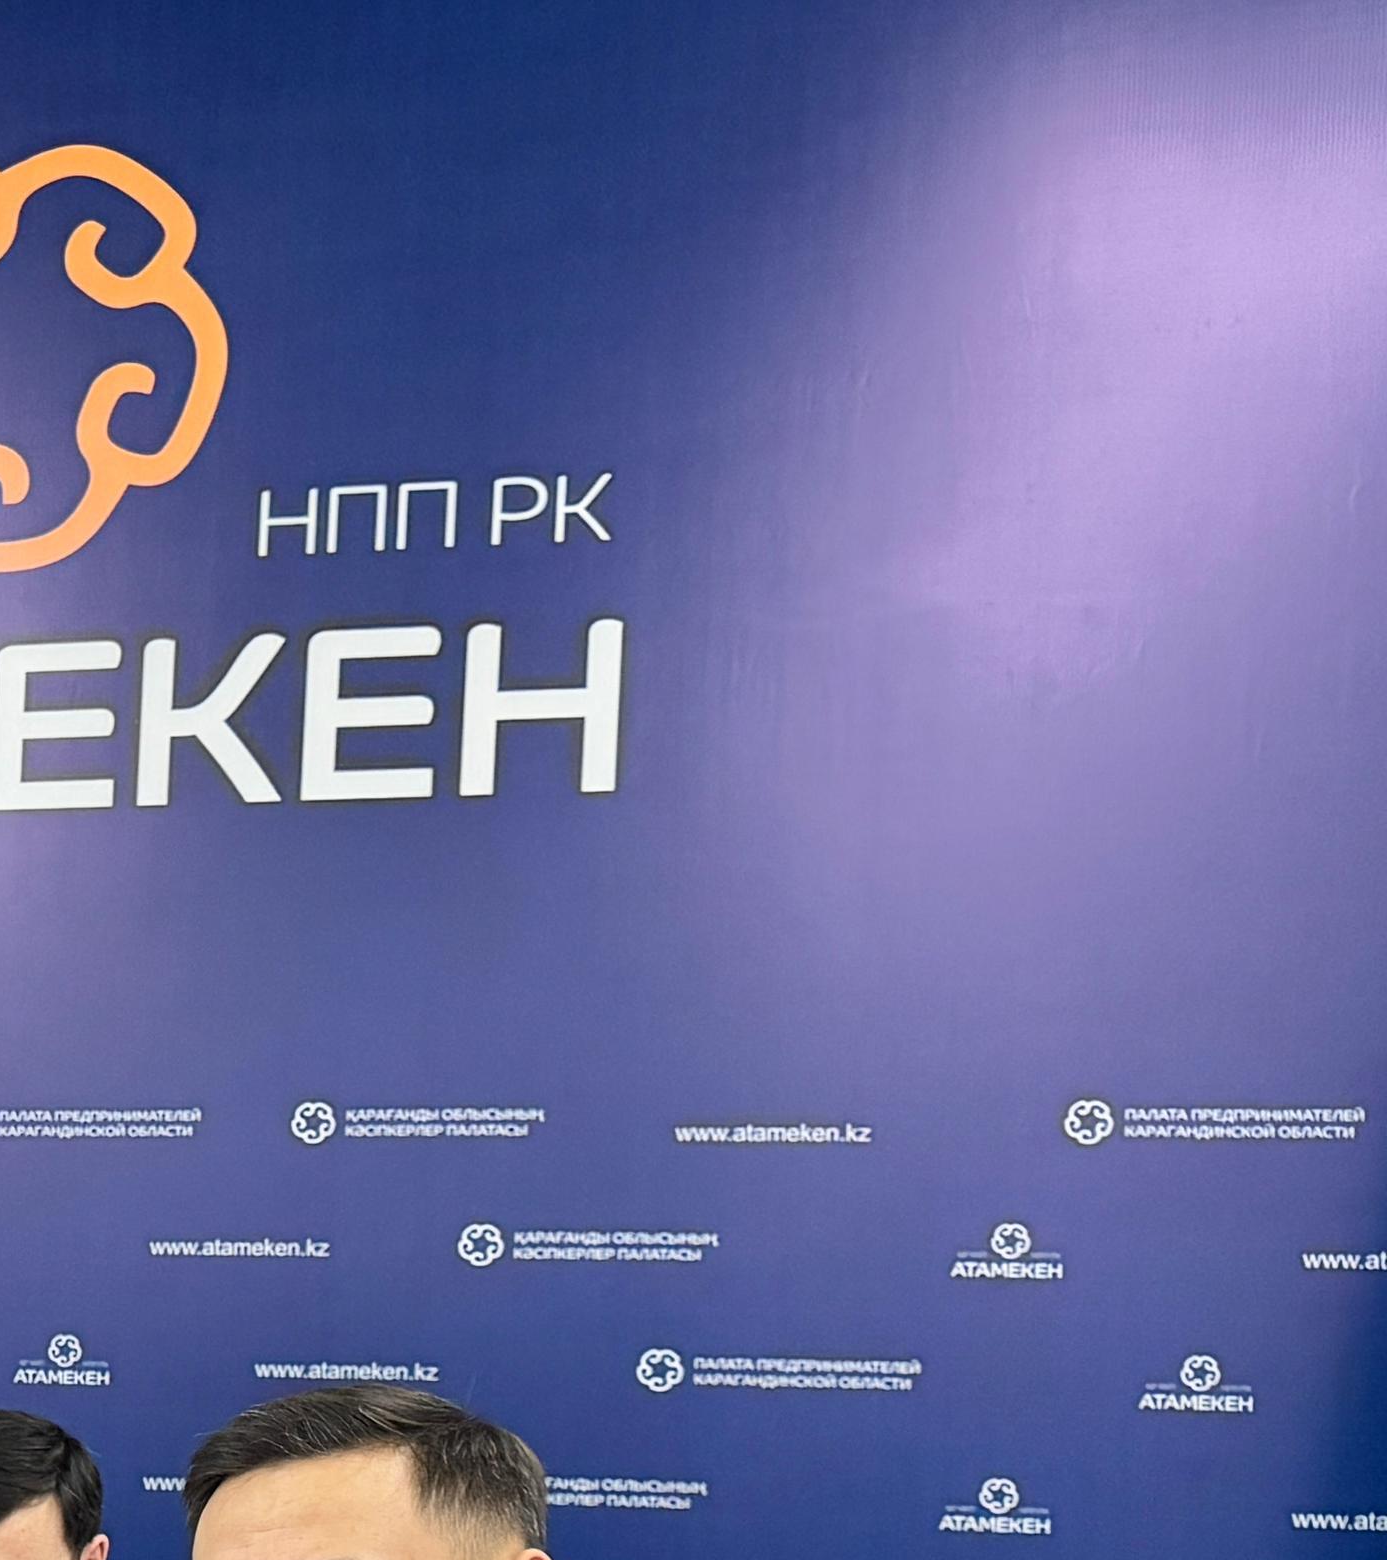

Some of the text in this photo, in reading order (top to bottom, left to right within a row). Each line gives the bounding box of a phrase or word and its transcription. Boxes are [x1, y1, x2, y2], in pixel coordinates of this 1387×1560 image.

[258, 473, 612, 556] НПП РК
[0, 1110, 52, 1122] ПАЛАТА
[1125, 1108, 1188, 1121] ПАЛАТА
[128, 1125, 194, 1138] ОБЛАСТИ
[675, 1123, 871, 1142] www.atameken.kz
[1278, 1126, 1356, 1139] ОБЛАСТИ
[150, 1238, 329, 1257] www.atameken.kz
[951, 1262, 1063, 1279] АТАМЕКЕН
[255, 1362, 439, 1382] www.atameken.kz
[694, 1357, 755, 1371] ПАЛАТА
[14, 1366, 110, 1385] АТАМЕКЕН
[839, 1376, 913, 1391] ОБЛАСТИ
[1139, 1394, 1253, 1412] АТАМЕКЕН
[939, 1515, 1051, 1534] АТАМЕКЕН
